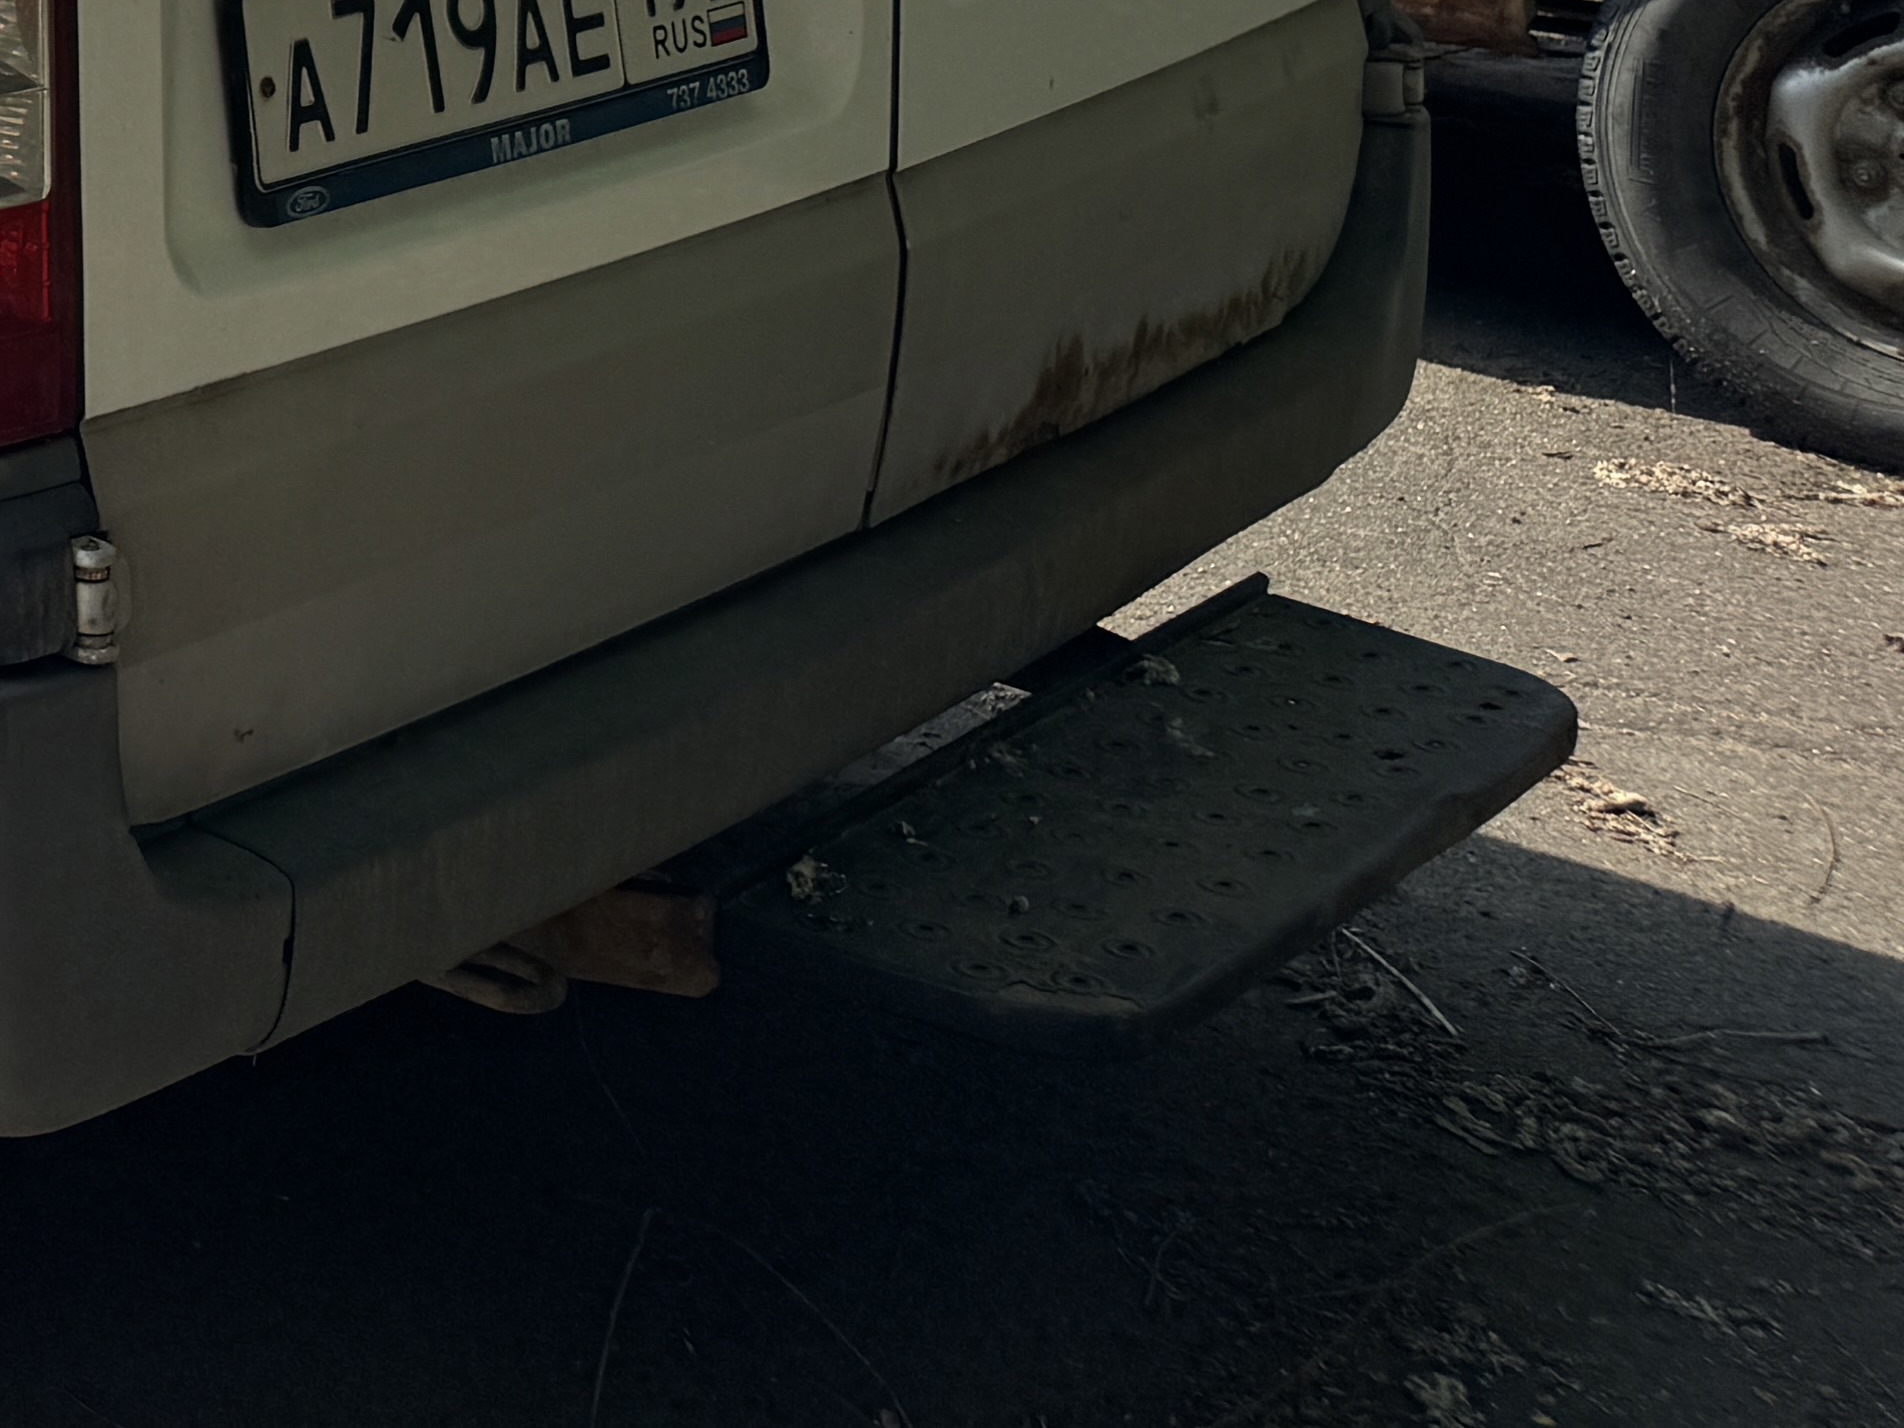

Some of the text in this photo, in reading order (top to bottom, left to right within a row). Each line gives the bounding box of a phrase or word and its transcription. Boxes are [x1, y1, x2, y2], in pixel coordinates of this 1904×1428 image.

[653, 14, 708, 60] RUS
[490, 118, 572, 165] MAJOR
[666, 80, 700, 111] 737
[706, 68, 750, 101] 4333
